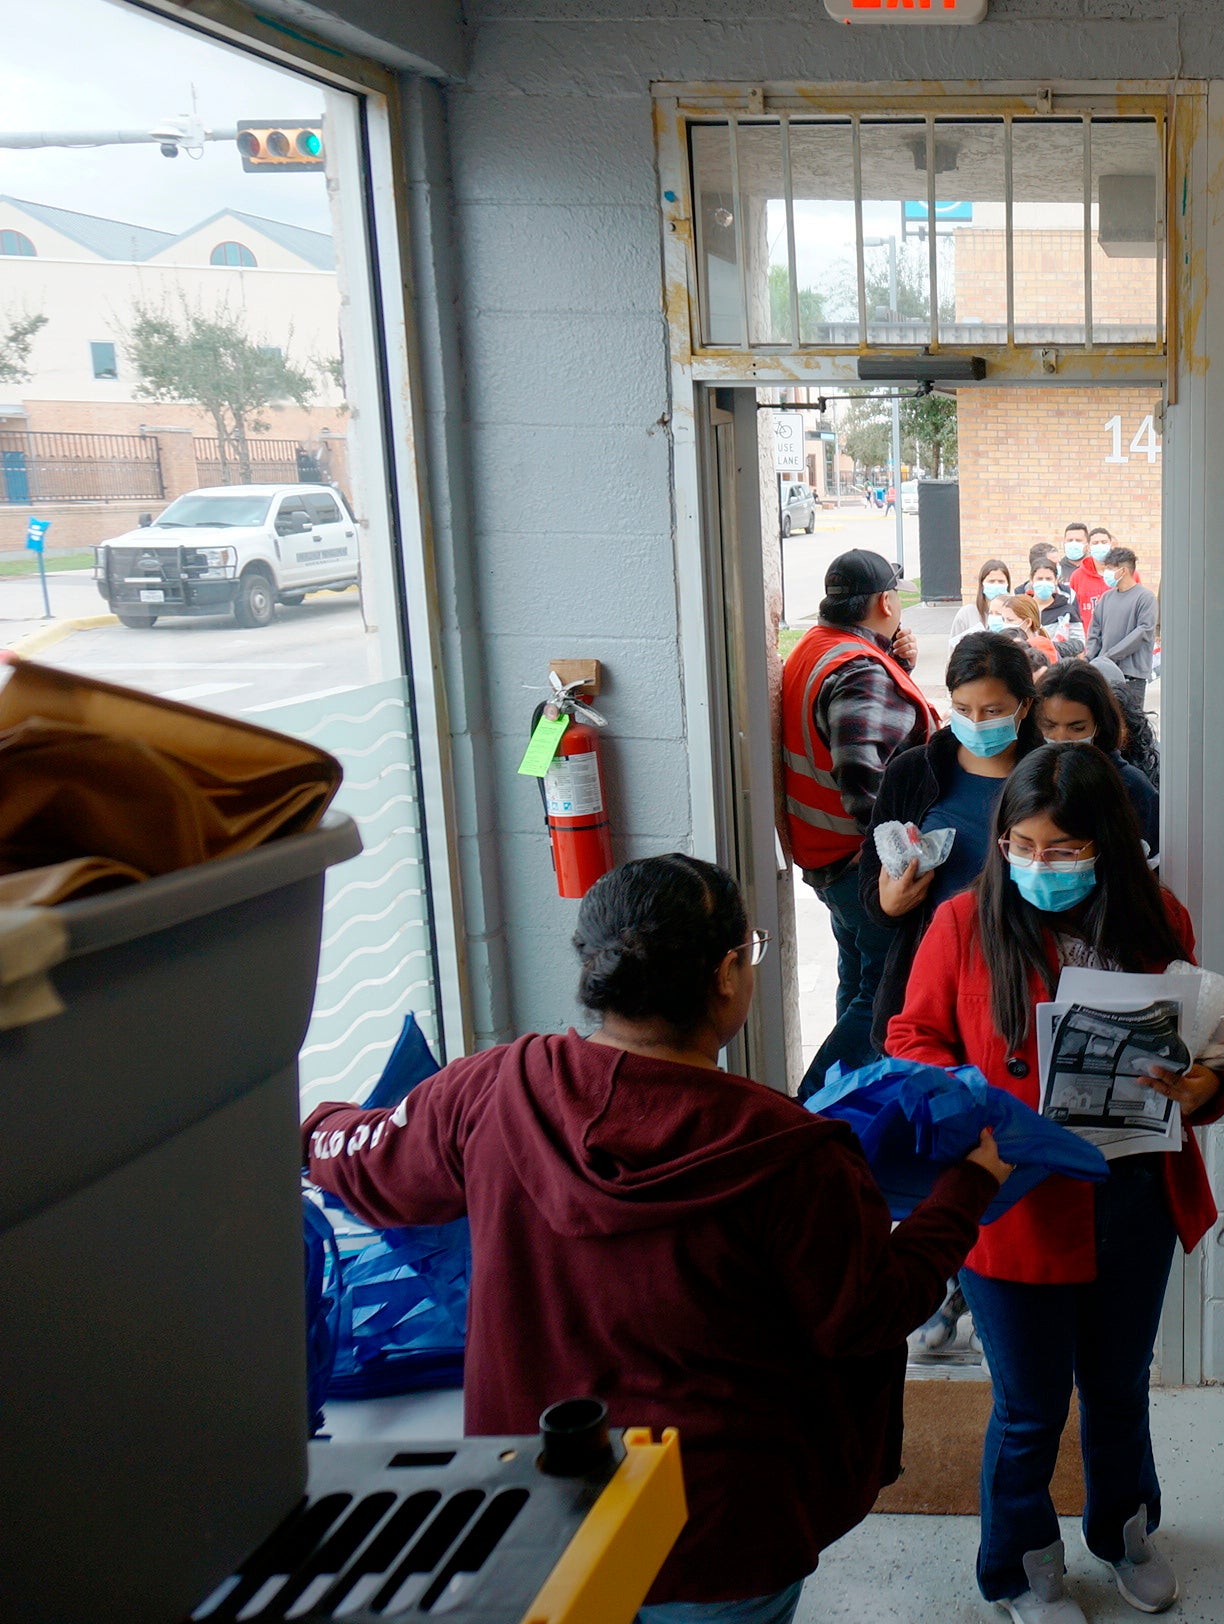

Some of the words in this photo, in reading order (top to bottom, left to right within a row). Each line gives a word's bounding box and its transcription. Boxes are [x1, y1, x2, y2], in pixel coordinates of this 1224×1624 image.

[1104, 414, 1162, 464] 14
[777, 443, 794, 452] USE
[777, 456, 799, 465] LANE
